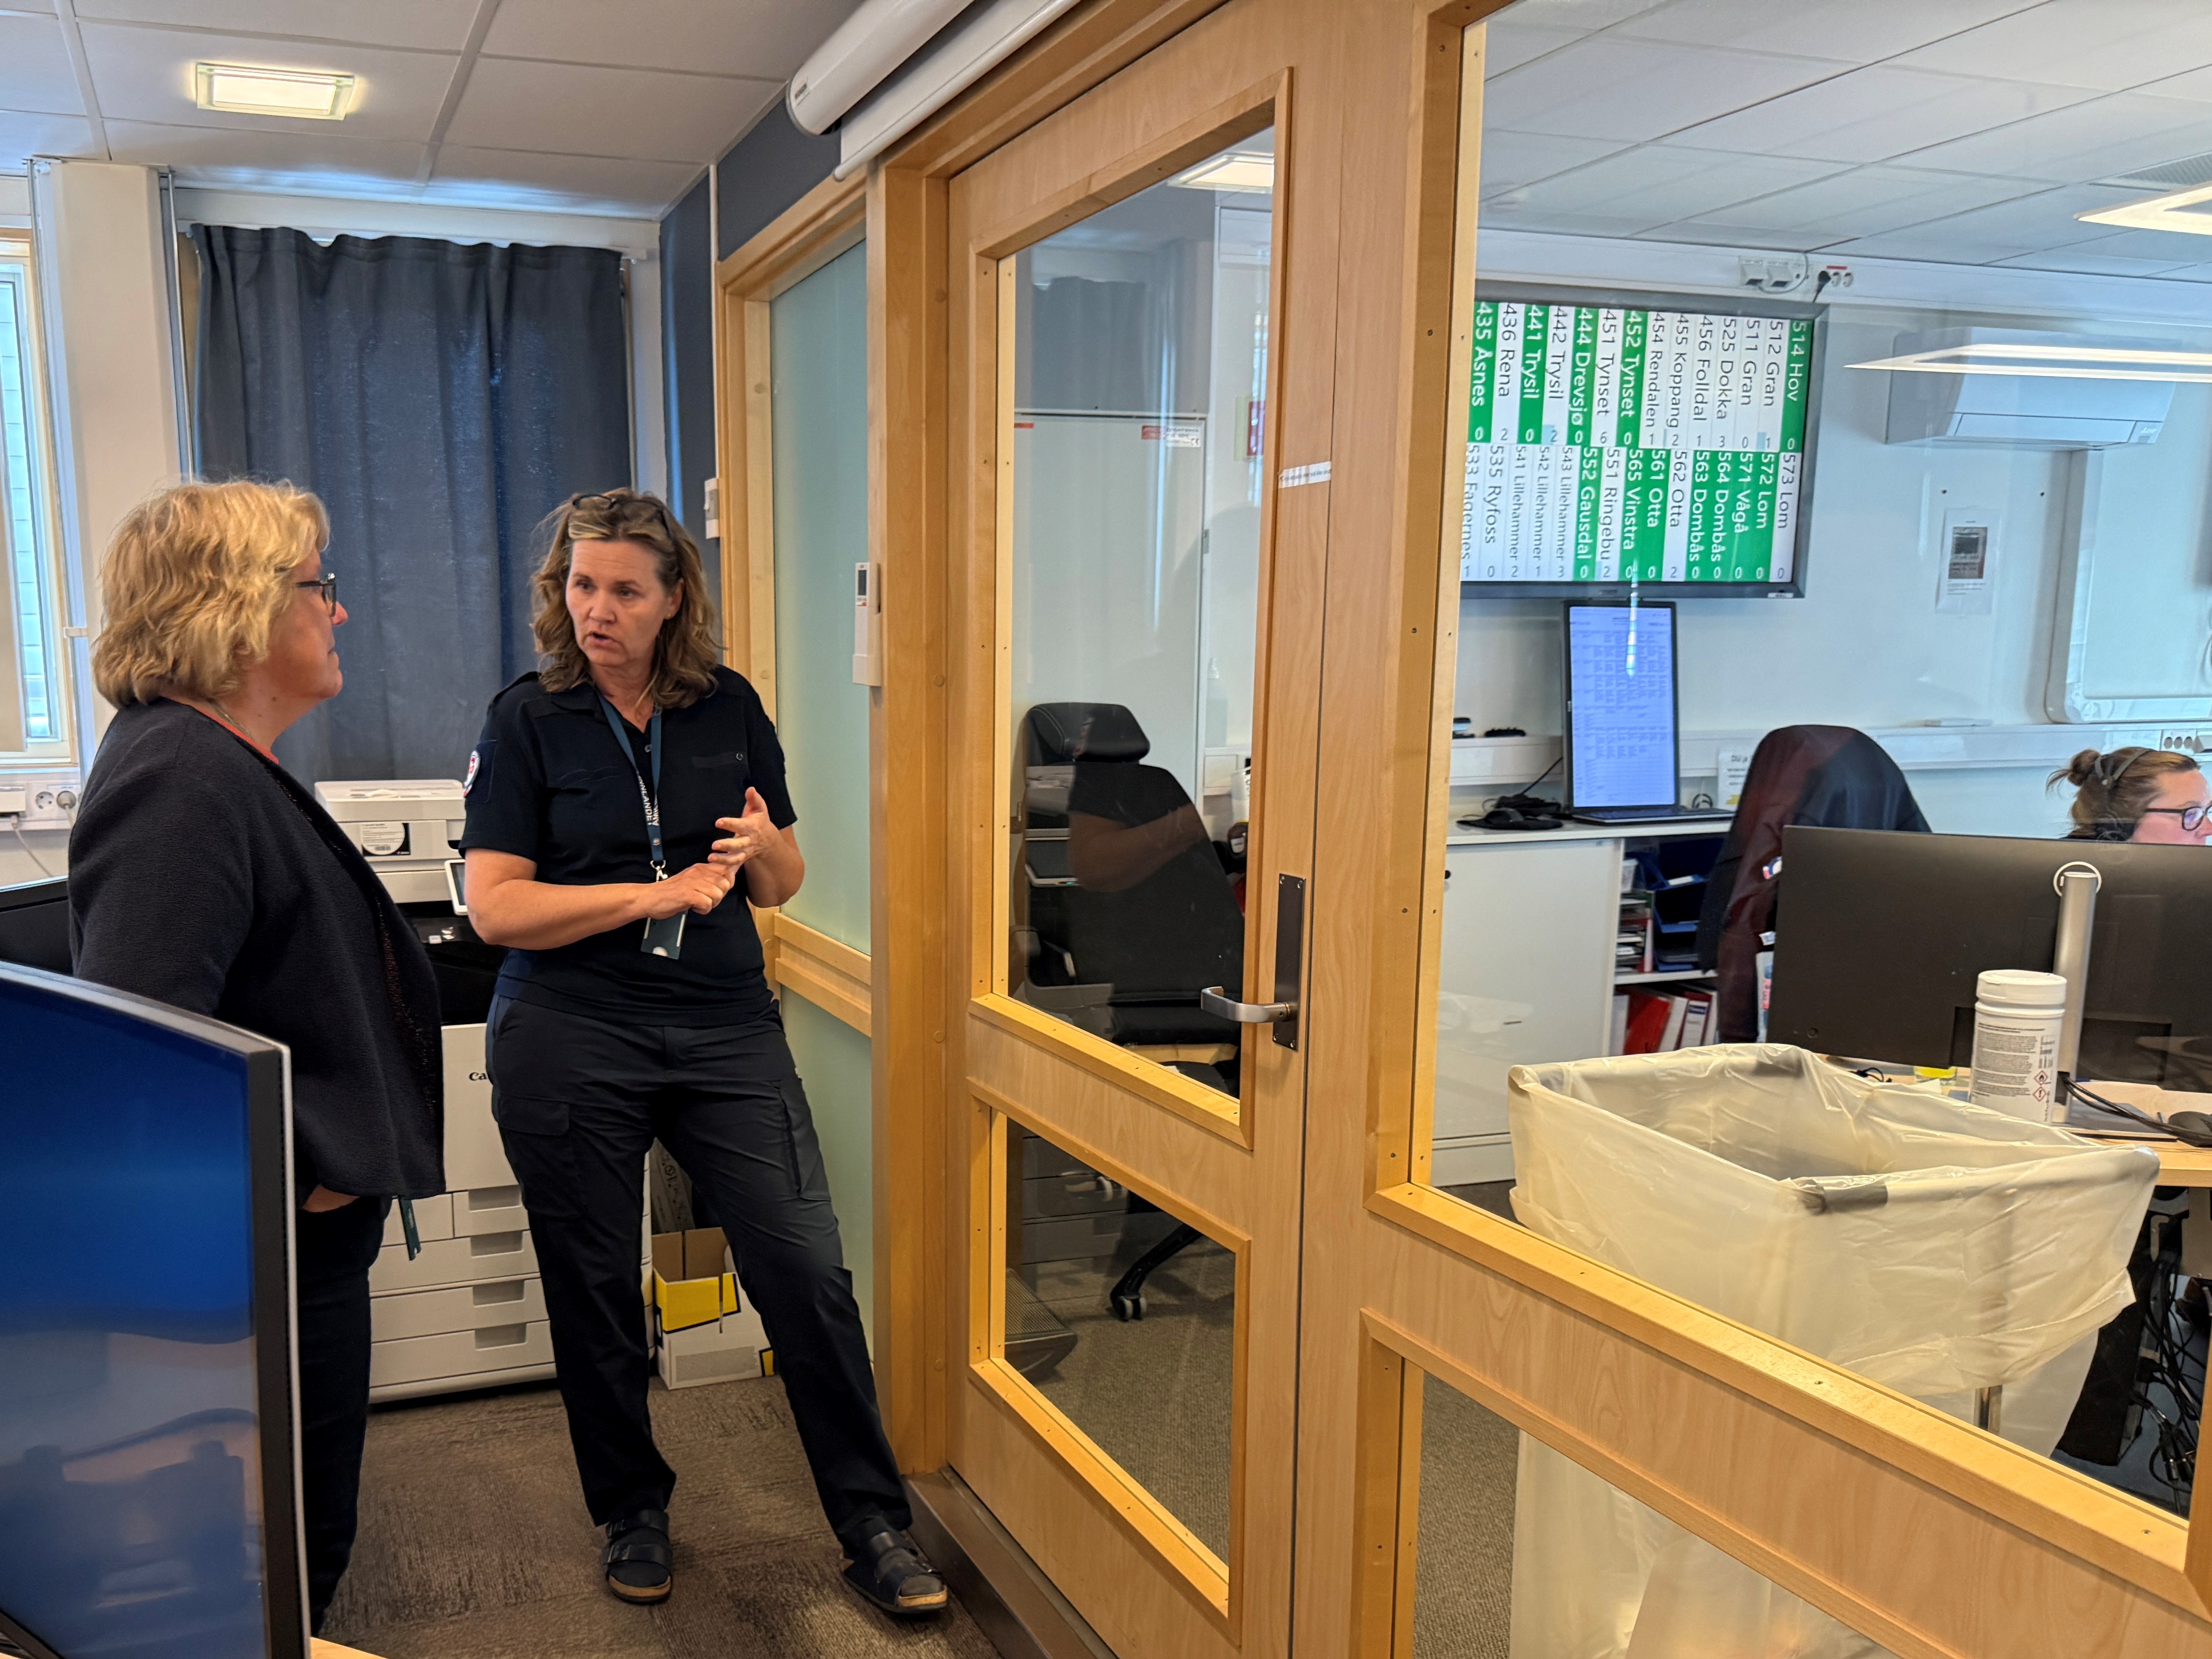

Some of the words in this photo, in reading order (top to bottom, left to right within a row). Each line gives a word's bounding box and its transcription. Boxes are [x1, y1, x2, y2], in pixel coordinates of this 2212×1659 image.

[1476, 302, 1492, 340] 435
[1501, 304, 1517, 341] 436
[1526, 304, 1543, 340] 441
[1552, 307, 1568, 343] 442
[1576, 308, 1593, 345] 444
[1601, 310, 1617, 343] 451
[1625, 311, 1642, 347] 452
[1651, 314, 1665, 342] 454
[1675, 315, 1689, 345] 455
[1698, 316, 1713, 351] 456
[1722, 318, 1736, 352] 525
[1744, 319, 1760, 351] 511
[1767, 321, 1783, 355] 512
[1791, 322, 1806, 356] 514
[1472, 346, 1492, 407] Åsnes
[1499, 350, 1515, 396] Rena
[1521, 349, 1542, 399] Trysil
[1545, 351, 1566, 399] Trysil
[1569, 352, 1591, 426] Drevsjø
[1596, 353, 1614, 416] Tynset
[1620, 354, 1639, 417] Tynset
[1645, 351, 1662, 427] Rendalen
[1741, 361, 1757, 405] Gran
[1764, 362, 1780, 406] Gran
[1787, 364, 1803, 401] Hov
[1666, 353, 1686, 428] Koppang
[1693, 360, 1710, 421] Folldal
[1716, 361, 1734, 419] Dokka
[1475, 426, 1484, 440] 0
[1501, 428, 1507, 441] 2
[1526, 429, 1534, 442] 0
[1551, 430, 1557, 442] 2
[1575, 431, 1583, 443] 0
[1600, 432, 1608, 444] 6
[1624, 432, 1632, 444] 0
[1649, 434, 1654, 444] 1
[1672, 434, 1679, 446] 2
[1697, 435, 1702, 446] 1
[1719, 436, 1725, 447] 3
[1742, 437, 1748, 447] 0
[1765, 438, 1770, 448] 1
[1788, 438, 1795, 449] 0
[1489, 445, 1504, 478] 535
[1515, 446, 1526, 469] 541
[1538, 447, 1550, 471] 542
[1561, 447, 1573, 471] 543
[1582, 447, 1598, 480] 552
[1606, 448, 1620, 478] 551
[1628, 449, 1644, 481] 565
[1650, 450, 1666, 480] 561
[1673, 451, 1688, 482] 562
[1695, 451, 1710, 482] 563
[1717, 452, 1732, 484] 564
[1738, 453, 1754, 483] 571
[1759, 454, 1775, 485] 572
[1781, 454, 1796, 485] 573
[1484, 485, 1501, 544] Ryfoss
[1509, 476, 1525, 561] Lillehammer
[1533, 477, 1548, 561] Lillehammer
[1556, 477, 1572, 561] Lillehammer
[1577, 486, 1595, 560] Gausdal
[1599, 487, 1617, 560] Ringebu
[1623, 487, 1641, 550] Vinstra
[1647, 488, 1663, 528] Otta
[1670, 489, 1684, 528] Otta
[1732, 489, 1751, 533] Vågå
[1756, 491, 1772, 529] Lom
[1778, 492, 1793, 529] Lom
[1689, 489, 1707, 562] Dombås
[1711, 490, 1729, 562] Dombås
[1464, 566, 1470, 577] 1
[1487, 566, 1495, 577] 0
[1511, 566, 1517, 577] 2
[1535, 566, 1541, 577] 1
[1557, 566, 1564, 577] 3
[1580, 565, 1589, 578] 0
[1603, 566, 1610, 577] 2
[1648, 566, 1655, 578] 0
[1670, 567, 1677, 578] 2
[1692, 566, 1700, 578] 0
[1714, 566, 1721, 578] 0
[1735, 567, 1743, 579] 0
[1756, 567, 1764, 579] 0
[1777, 568, 1784, 578] 0
